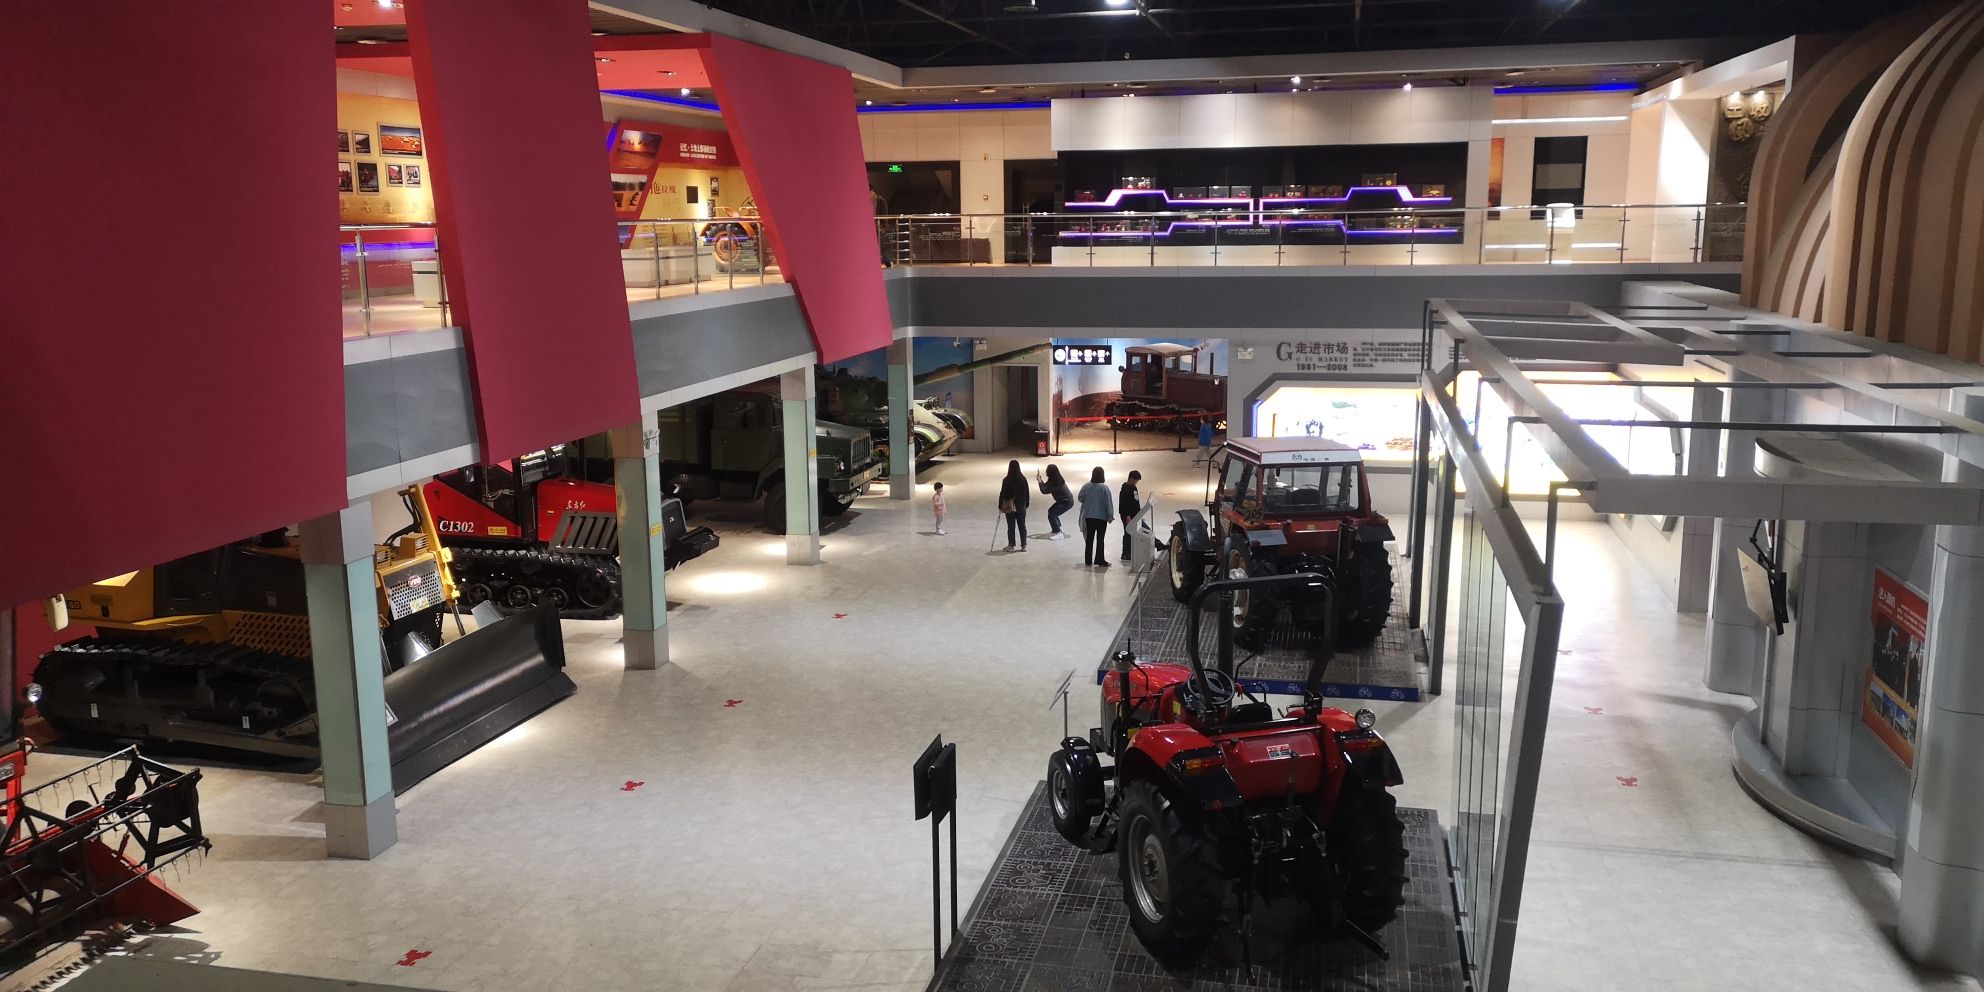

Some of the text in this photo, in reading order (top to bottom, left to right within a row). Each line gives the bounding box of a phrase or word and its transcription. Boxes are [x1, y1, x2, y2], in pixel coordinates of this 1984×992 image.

[1276, 341, 1293, 361] G
[1295, 341, 1349, 355] 走进市场
[439, 520, 475, 533] C1302
